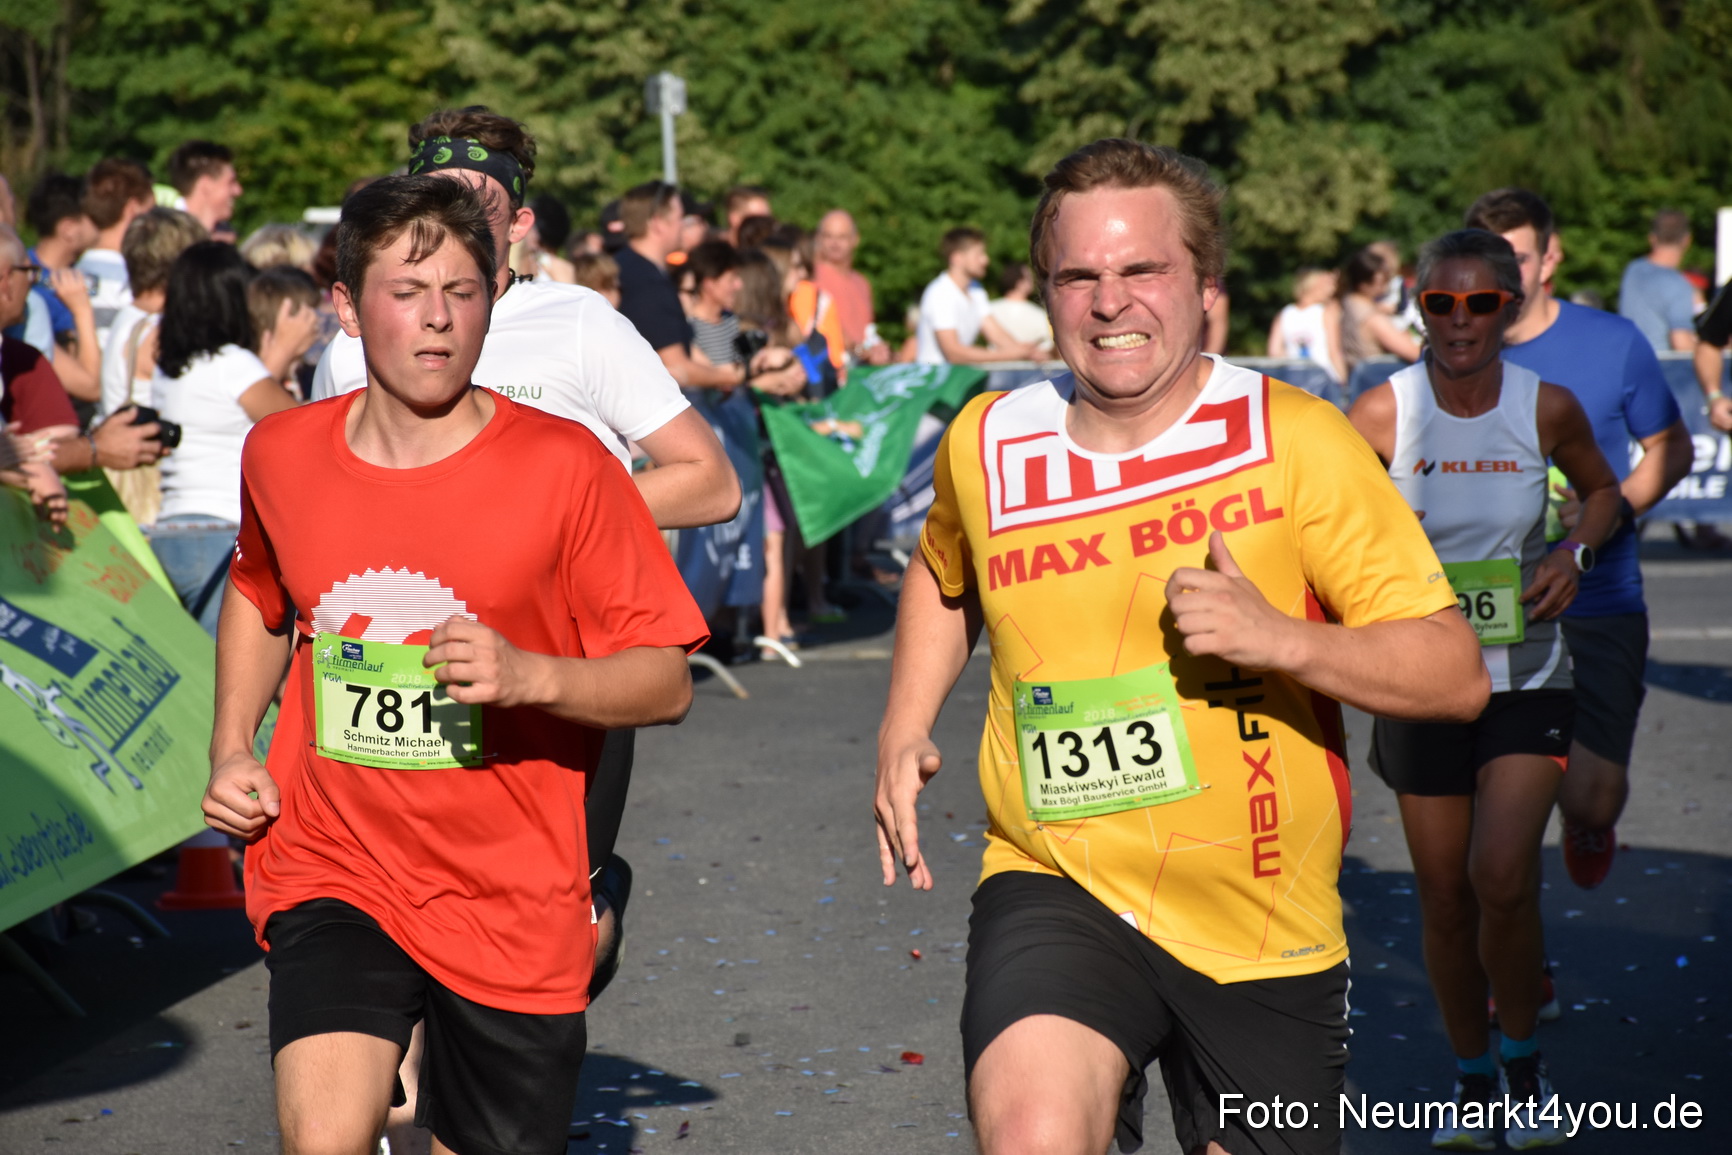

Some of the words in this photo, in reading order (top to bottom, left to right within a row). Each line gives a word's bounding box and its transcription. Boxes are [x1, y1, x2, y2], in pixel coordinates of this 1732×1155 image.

[490, 385, 542, 400] ZBAU
[1441, 460, 1523, 473] KLEBL
[988, 532, 1112, 591] MAX
[1128, 487, 1284, 558] BÖGL
[1456, 591, 1496, 621] 96
[1474, 621, 1508, 633] Sylvana
[332, 655, 384, 673] firmenlauf
[391, 673, 422, 684] 2018
[345, 683, 432, 734] 781
[1027, 701, 1074, 715] firmenlauf
[1083, 708, 1116, 722] 2018
[343, 729, 391, 746] Schmitz
[394, 736, 446, 748] Michael
[347, 743, 410, 757] Hammerbacher
[412, 749, 440, 758] GmbH
[1032, 720, 1162, 779] 1313
[1039, 775, 1119, 796] Miaskiwskyi
[1122, 767, 1165, 784] Ewald
[1041, 796, 1058, 806] Max
[1060, 794, 1081, 806] Bögl
[1083, 788, 1136, 802] Bauservice
[1137, 781, 1168, 794] GmbH
